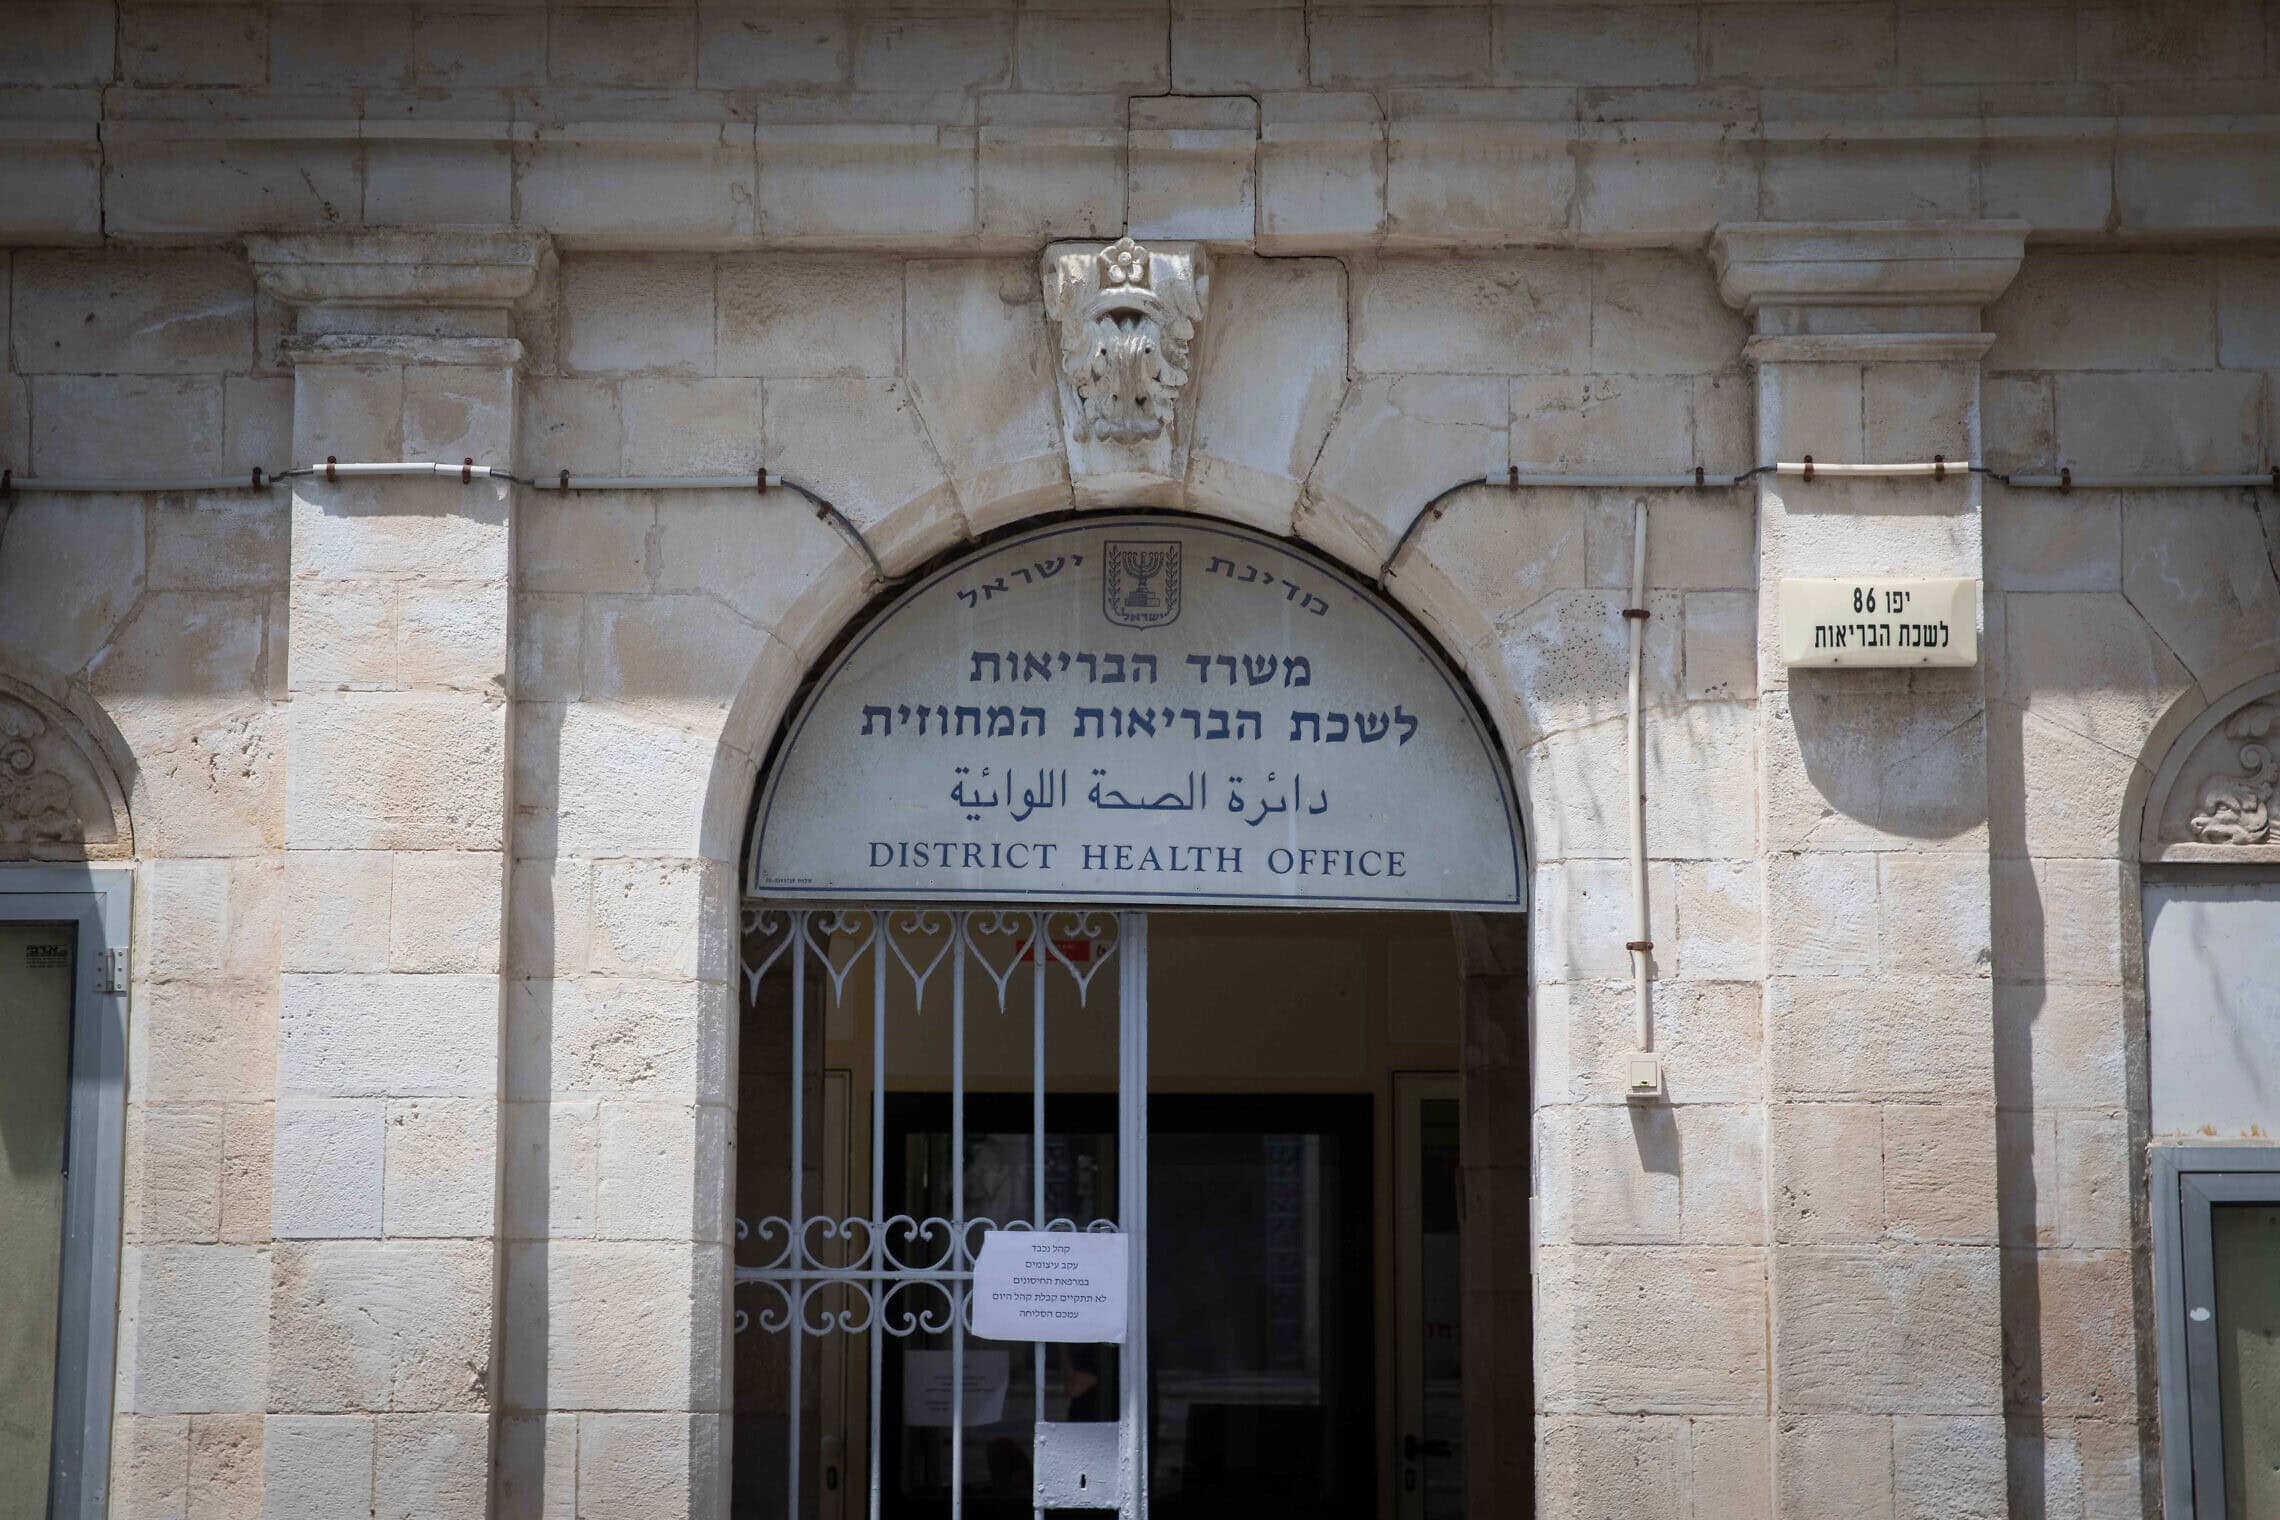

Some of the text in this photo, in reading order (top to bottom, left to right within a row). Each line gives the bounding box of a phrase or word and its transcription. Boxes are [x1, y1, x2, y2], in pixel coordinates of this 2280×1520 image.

[956, 554, 1330, 617] מדינת ישראל
[1853, 587, 1911, 614] יפו 86
[1121, 607, 1165, 622] ישראל
[1814, 620, 1949, 648] לשכת הבריאות
[969, 650, 1311, 689] משרד הבריאות
[860, 703, 1419, 747] לשכת הבריאות המחוזית
[950, 766, 1328, 827] دائرة الصحة اللوائية
[868, 841, 1407, 878] DISTRICT HEALTH OFFICE
[1031, 1244, 1071, 1254] קהל נכבד
[1025, 1260, 1079, 1271] עקב עיצומים
[1013, 1276, 1089, 1286] במרפאת החיסונים
[992, 1292, 1107, 1304] לא תתקיים קבלת קהל היום
[1019, 1308, 1080, 1319] עמכם הסליחה
